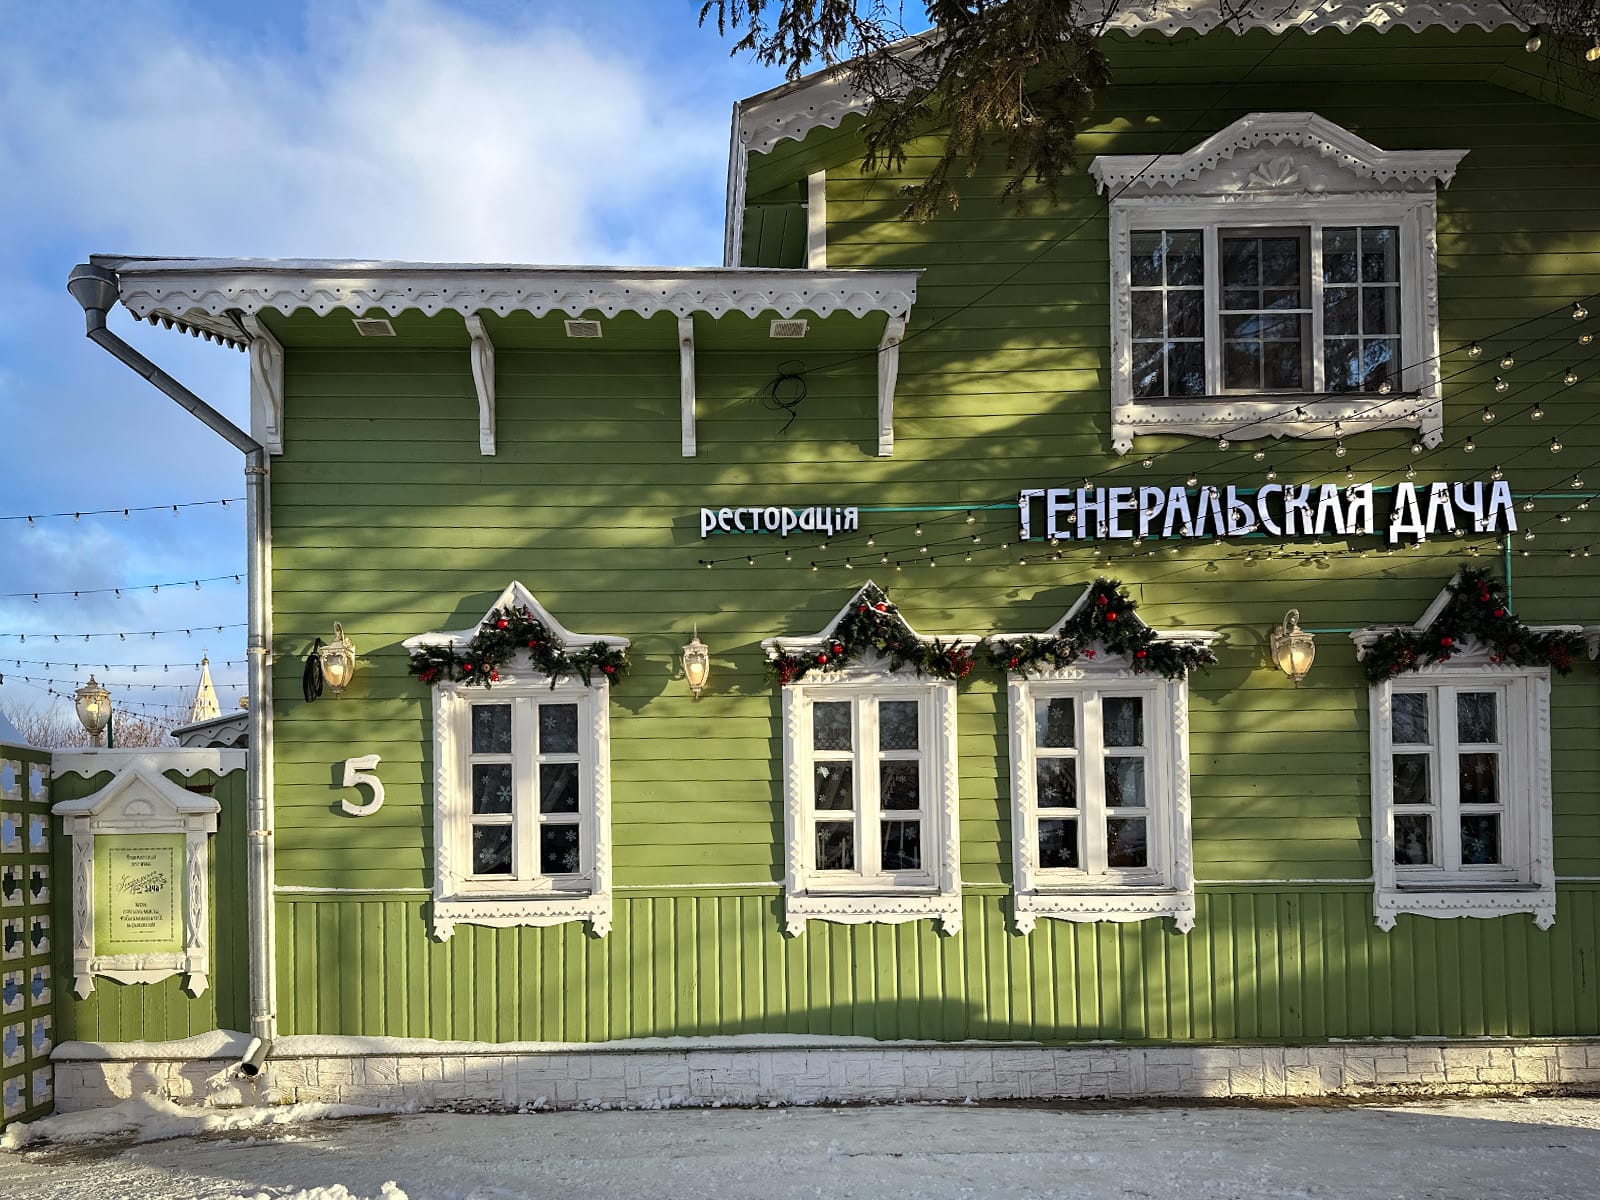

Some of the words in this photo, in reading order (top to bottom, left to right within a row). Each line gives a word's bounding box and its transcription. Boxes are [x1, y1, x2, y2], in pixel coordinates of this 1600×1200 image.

[1019, 483, 1374, 539] ГЕНЕРАЛЬСКАЯ
[1389, 480, 1518, 543] ДАЧА
[341, 754, 385, 816] 5
